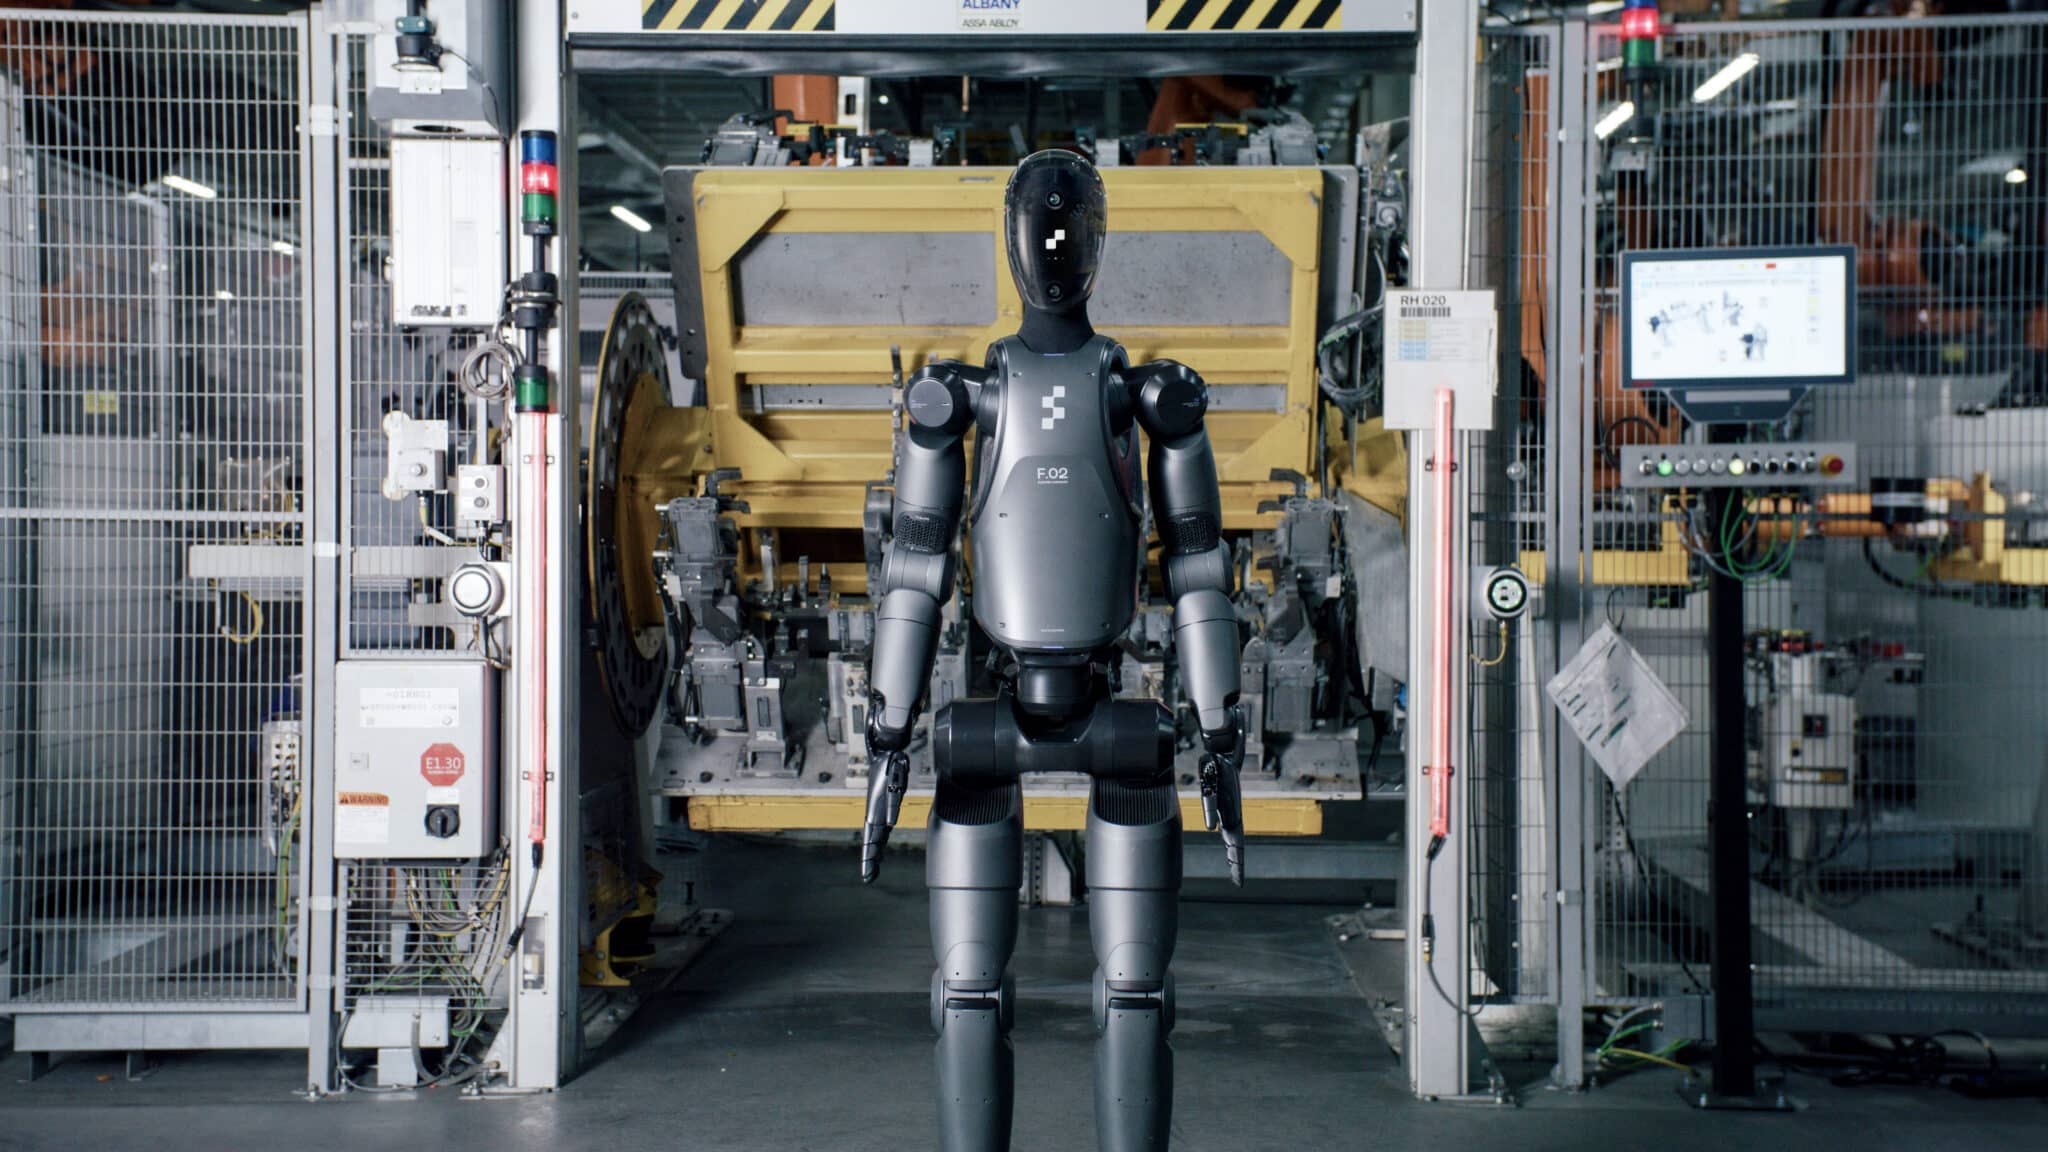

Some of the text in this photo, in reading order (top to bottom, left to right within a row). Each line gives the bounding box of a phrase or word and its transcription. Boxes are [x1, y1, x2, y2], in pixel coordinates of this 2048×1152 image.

[962, 0, 1021, 9] ALBANY
[962, 18, 1019, 28] ASSA ABLOY
[1400, 295, 1447, 305] RH 020
[1037, 467, 1069, 480] F.02
[425, 756, 461, 770] E1.30
